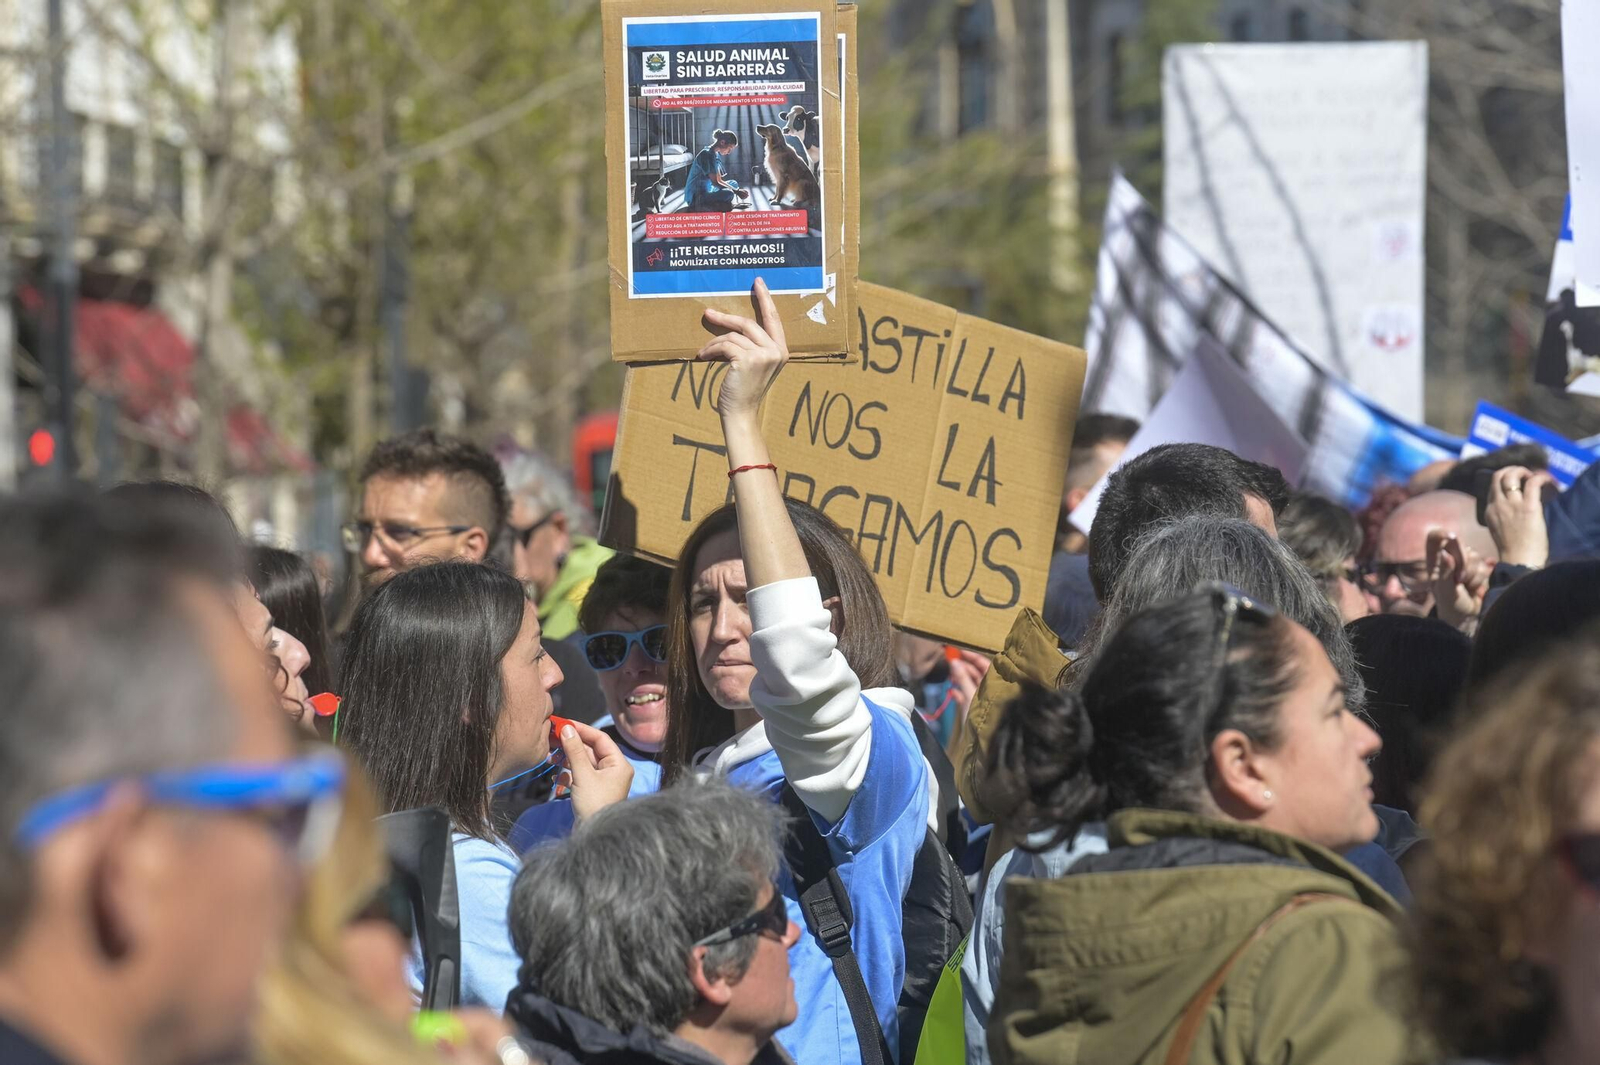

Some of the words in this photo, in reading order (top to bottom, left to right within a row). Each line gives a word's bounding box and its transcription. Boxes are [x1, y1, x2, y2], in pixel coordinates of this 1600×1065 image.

[676, 49, 726, 64] SALUD
[729, 48, 790, 62] ANIMAL
[676, 64, 704, 78] SIN
[706, 62, 786, 78] BARRERAS
[670, 246, 692, 258] ¡¡TE
[694, 244, 785, 256] NECESITAMOS!!
[670, 258, 718, 267] MOVILÍZATE
[719, 258, 739, 266] CON
[740, 256, 785, 265] NOSOTROS
[789, 381, 888, 460] NOS
[937, 423, 1003, 507] LA
